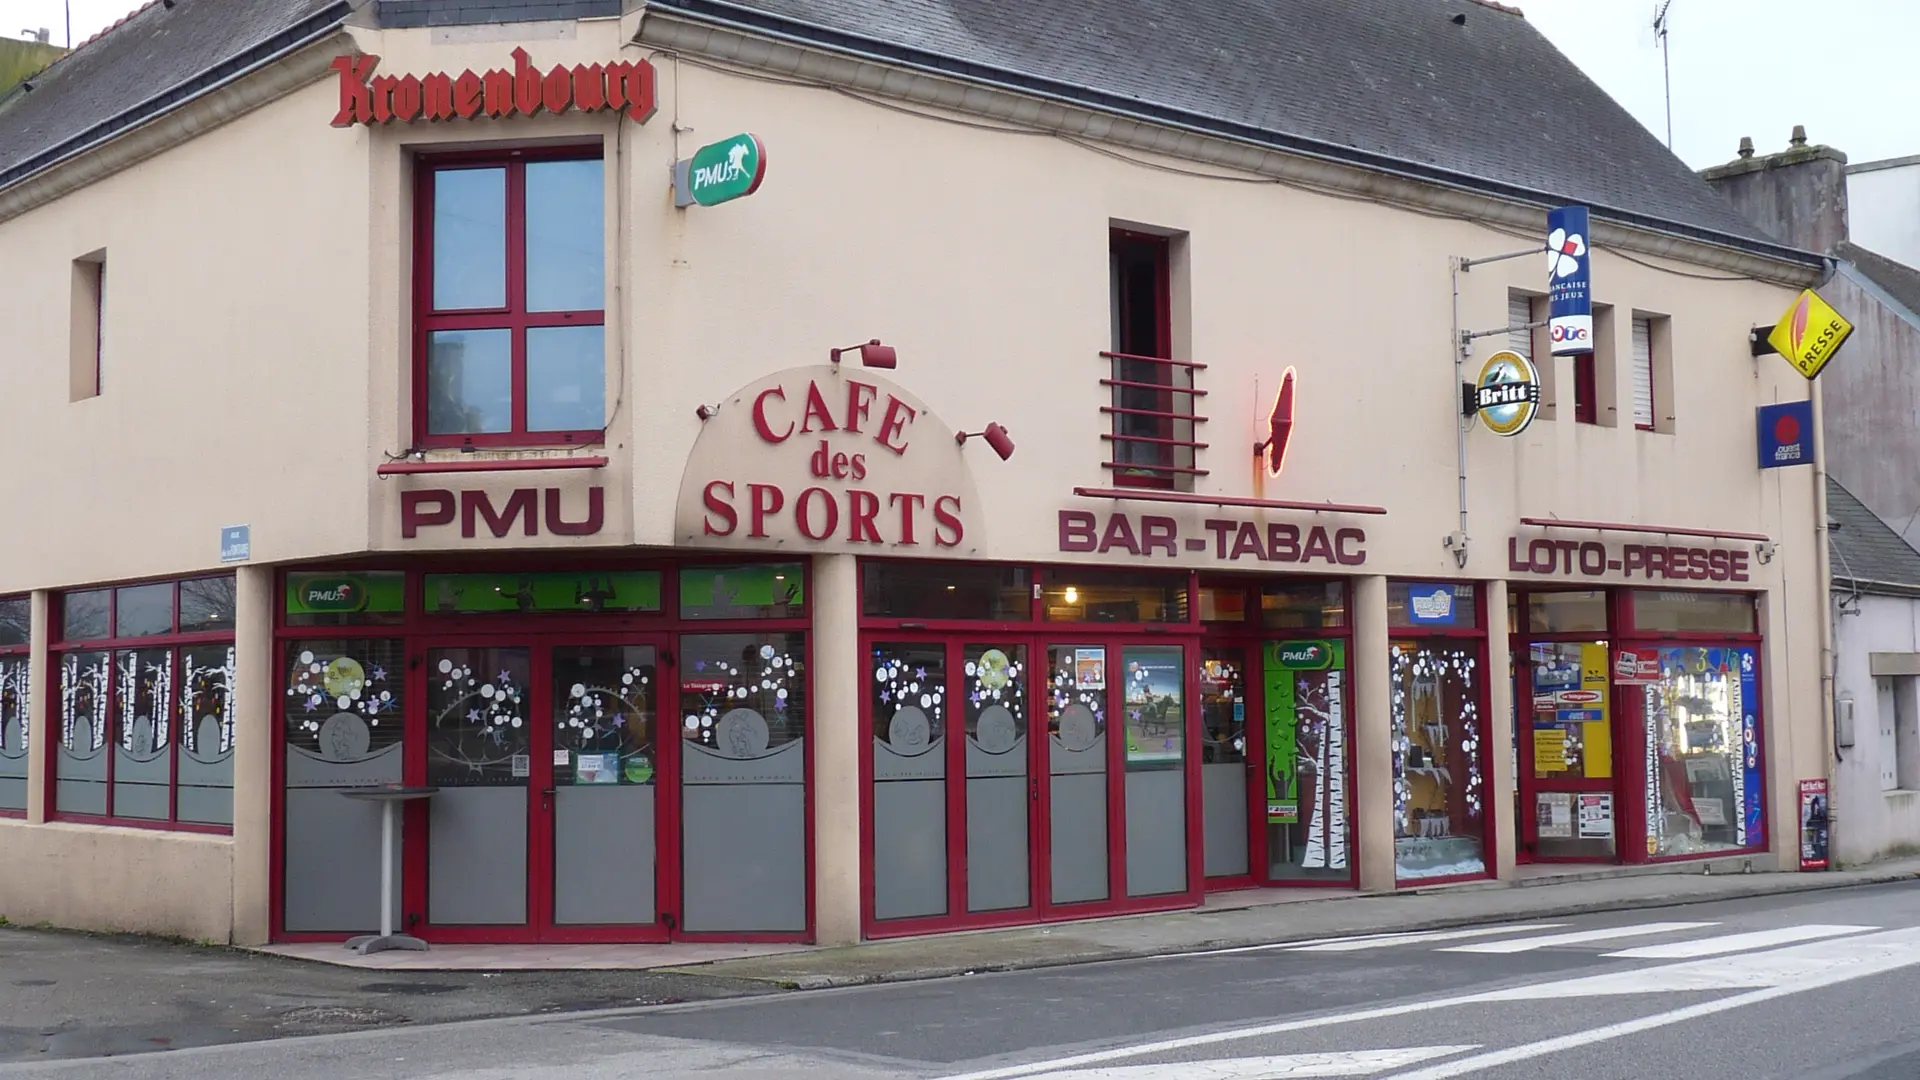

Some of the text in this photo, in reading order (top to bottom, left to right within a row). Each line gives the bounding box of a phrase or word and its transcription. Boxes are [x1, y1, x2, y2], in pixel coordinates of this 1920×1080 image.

[330, 46, 657, 127] Kronenbourg
[694, 161, 729, 190] PMU
[1561, 291, 1584, 301] JEUX
[1799, 320, 1842, 371] PRESSE
[1480, 385, 1527, 406] Britt
[753, 380, 916, 455] CAFE
[811, 440, 867, 480] des
[1775, 450, 1800, 461] france
[1777, 443, 1800, 453] ouest
[401, 487, 604, 538] PMU
[703, 480, 963, 547] SPORTS
[1058, 509, 1367, 566] BAR-TABAC
[1508, 537, 1750, 582] LOTO-PRESSE
[308, 590, 336, 601] PMU
[1282, 651, 1306, 661] PMU
